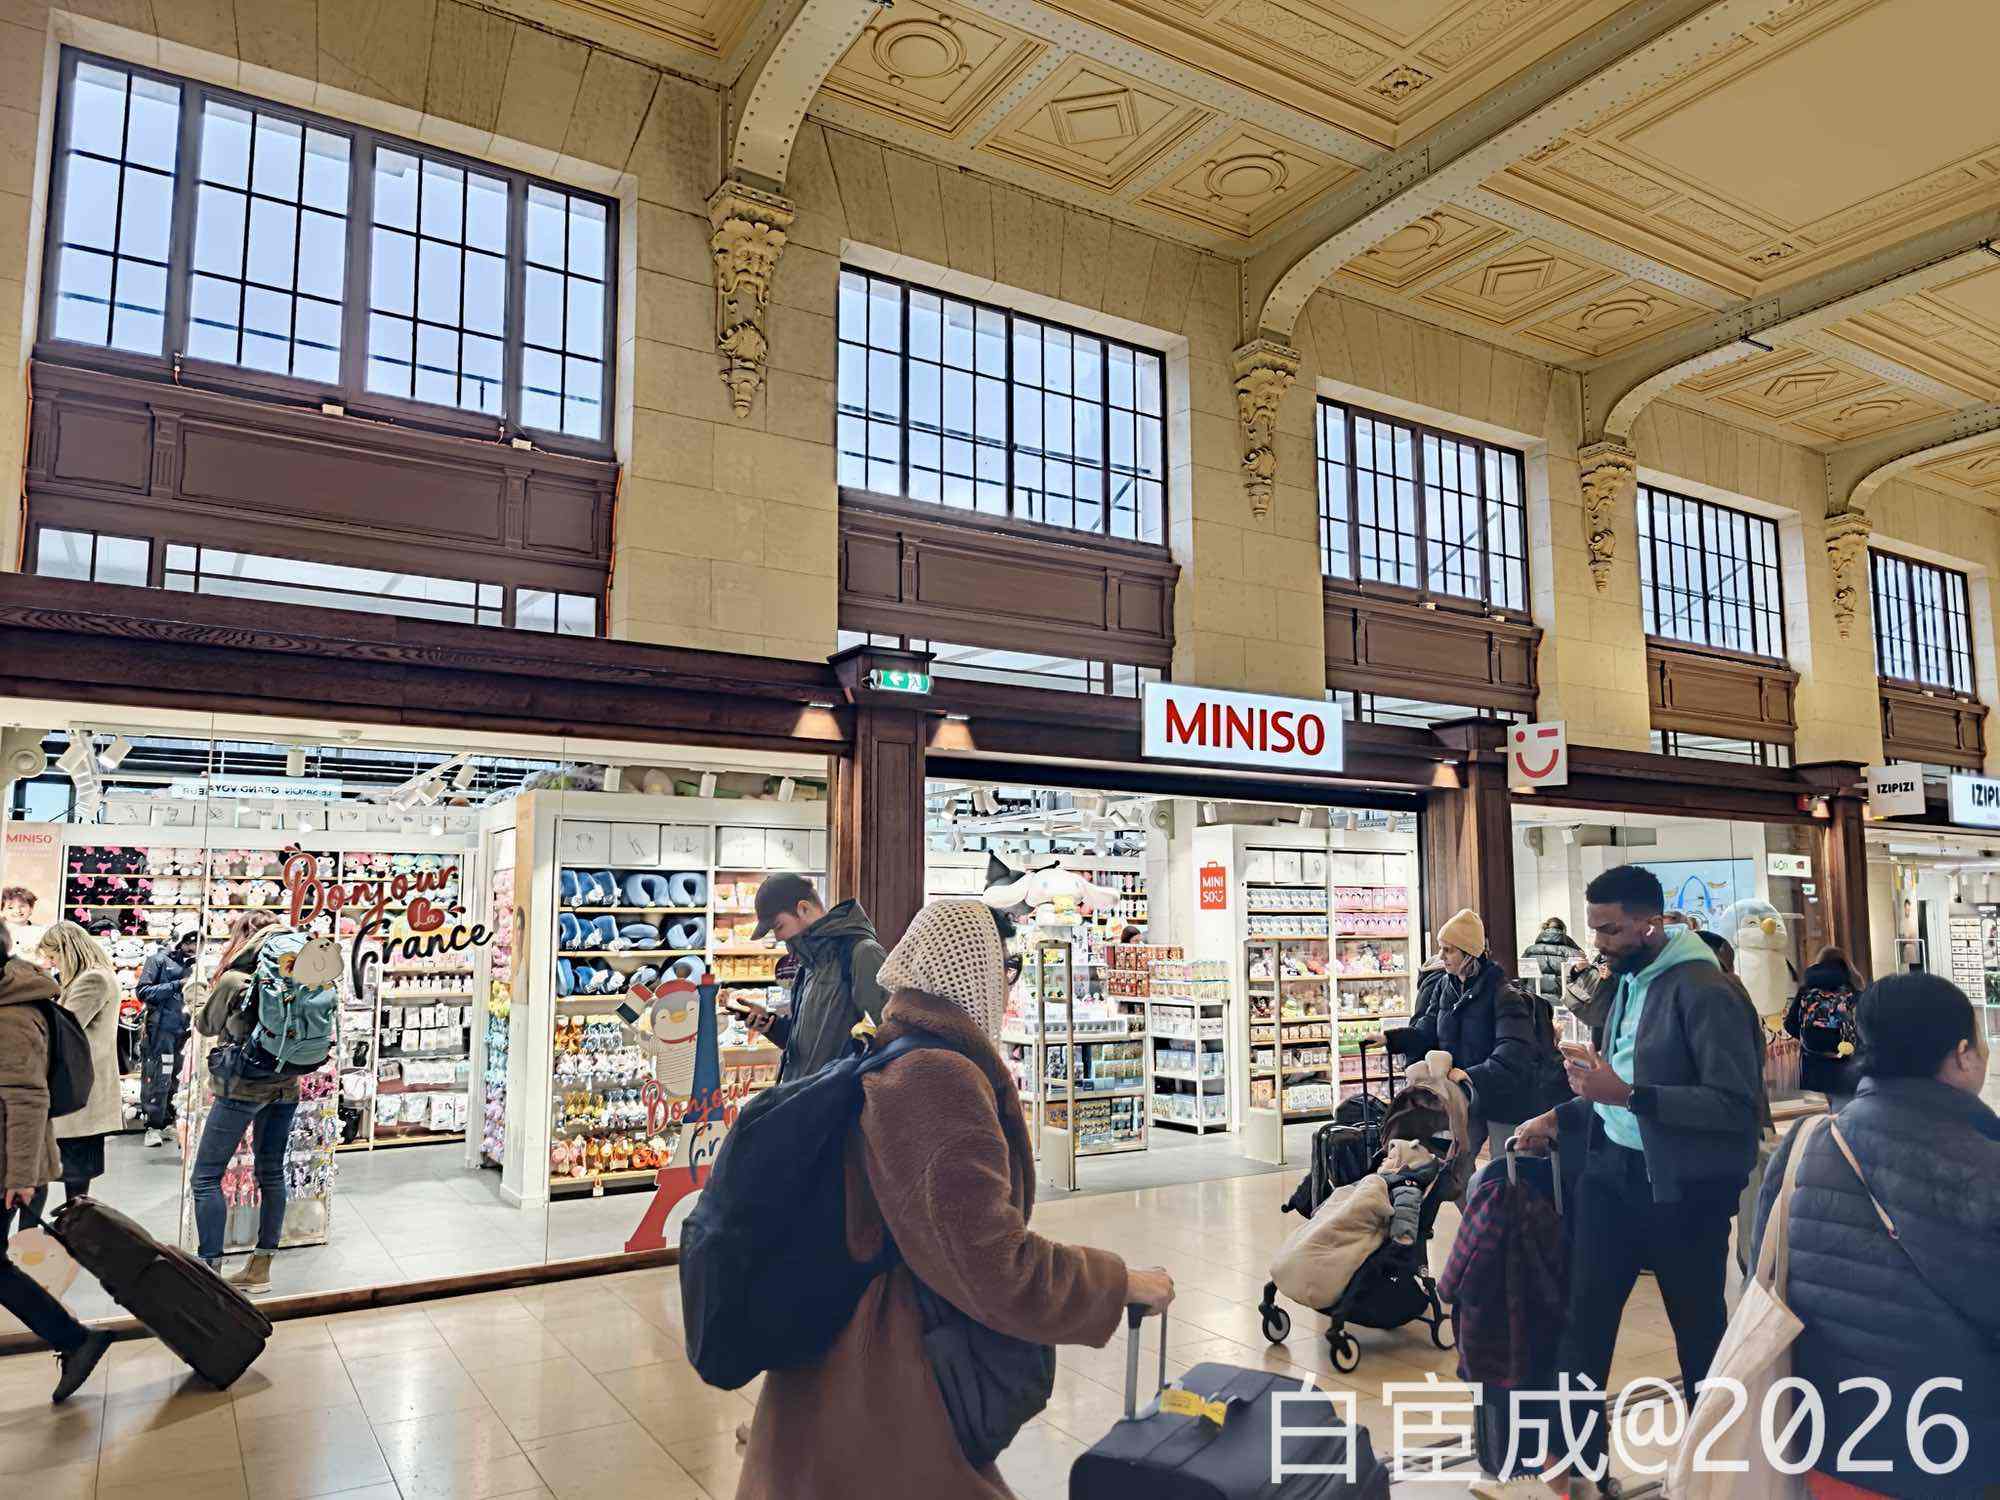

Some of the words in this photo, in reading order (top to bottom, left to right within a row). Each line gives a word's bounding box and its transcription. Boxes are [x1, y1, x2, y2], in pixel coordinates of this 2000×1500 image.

[1166, 699, 1325, 755] MINISO
[1877, 782, 1914, 793] IZIPIZI
[7, 833, 52, 843] MINISO
[284, 853, 457, 935] Bonjour
[1202, 877, 1224, 888] MINI
[414, 903, 438, 926] La
[352, 919, 494, 999] France
